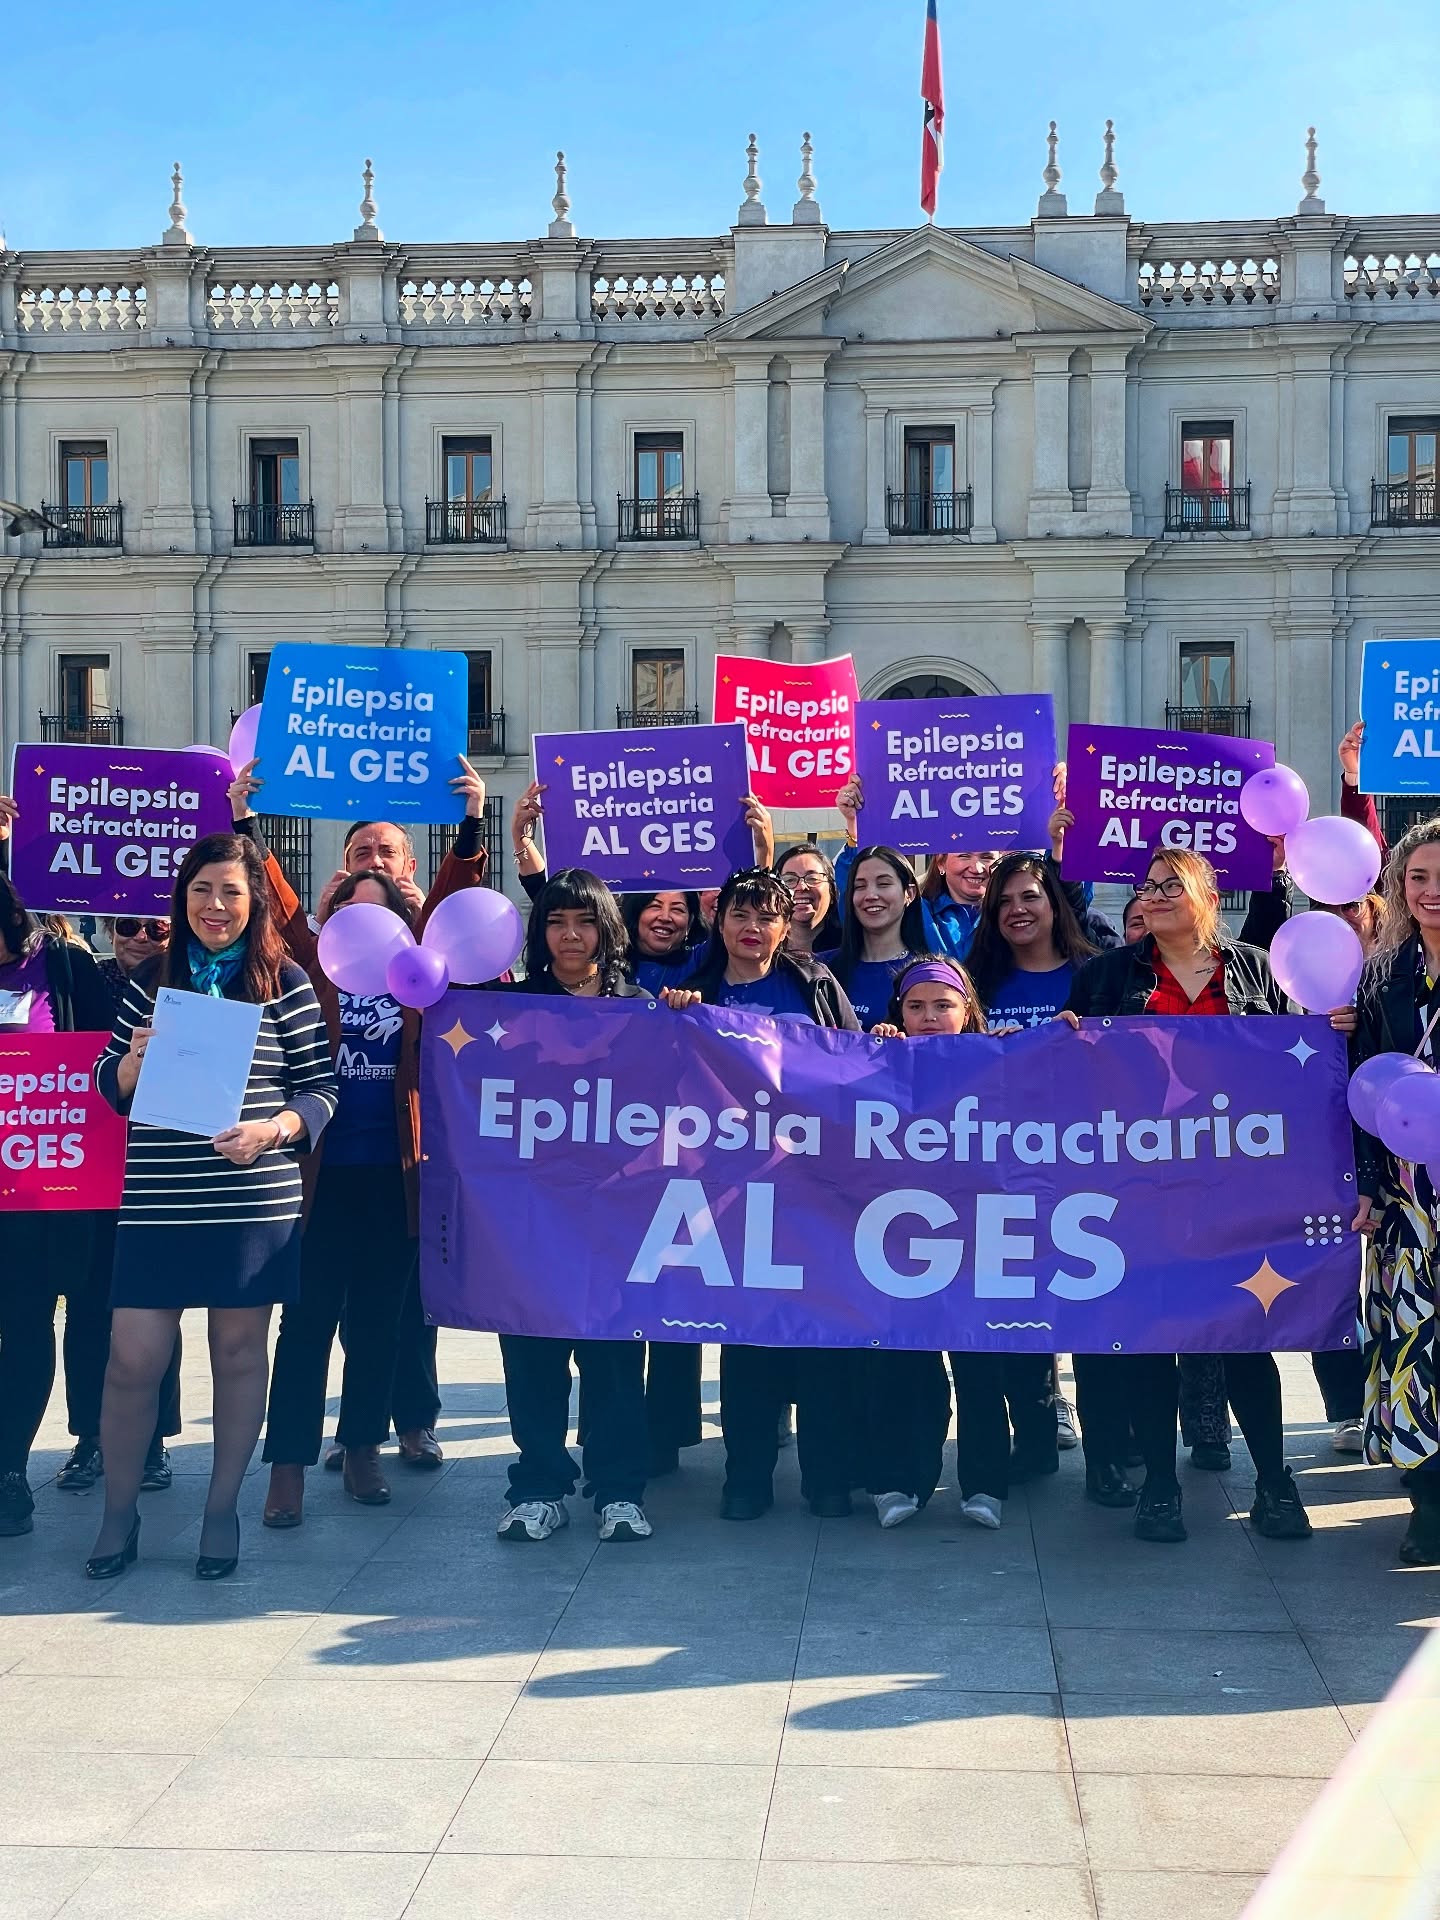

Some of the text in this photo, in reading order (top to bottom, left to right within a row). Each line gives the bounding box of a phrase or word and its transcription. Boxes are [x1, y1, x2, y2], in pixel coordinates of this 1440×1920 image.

[291, 677, 434, 716] Epilepsia
[735, 686, 849, 723] Epilepsia
[287, 713, 431, 742] Refractaria
[888, 725, 1024, 761] Epilepsia
[1392, 729, 1440, 758] AL
[284, 745, 429, 784] AL GES
[571, 758, 713, 797] Epilepsia
[788, 746, 852, 778] GES
[889, 758, 1024, 782] Refractaria
[1101, 755, 1242, 791] Epilepsia
[50, 777, 200, 814] Epilepsia
[575, 792, 714, 818] Refractaria
[891, 785, 1025, 820] AL GES
[1100, 788, 1239, 815] Refractaria
[49, 812, 197, 840] Refractaria
[581, 820, 716, 856] AL GES
[1098, 817, 1237, 854] AL GES
[49, 842, 102, 875] AL
[989, 1004, 1056, 1016] La epilepsia
[0, 1101, 86, 1126] ctaria
[479, 1078, 1285, 1167] Epilepsia Refractaria
[1, 1132, 85, 1170] GES
[626, 1179, 1126, 1300] AL GES
